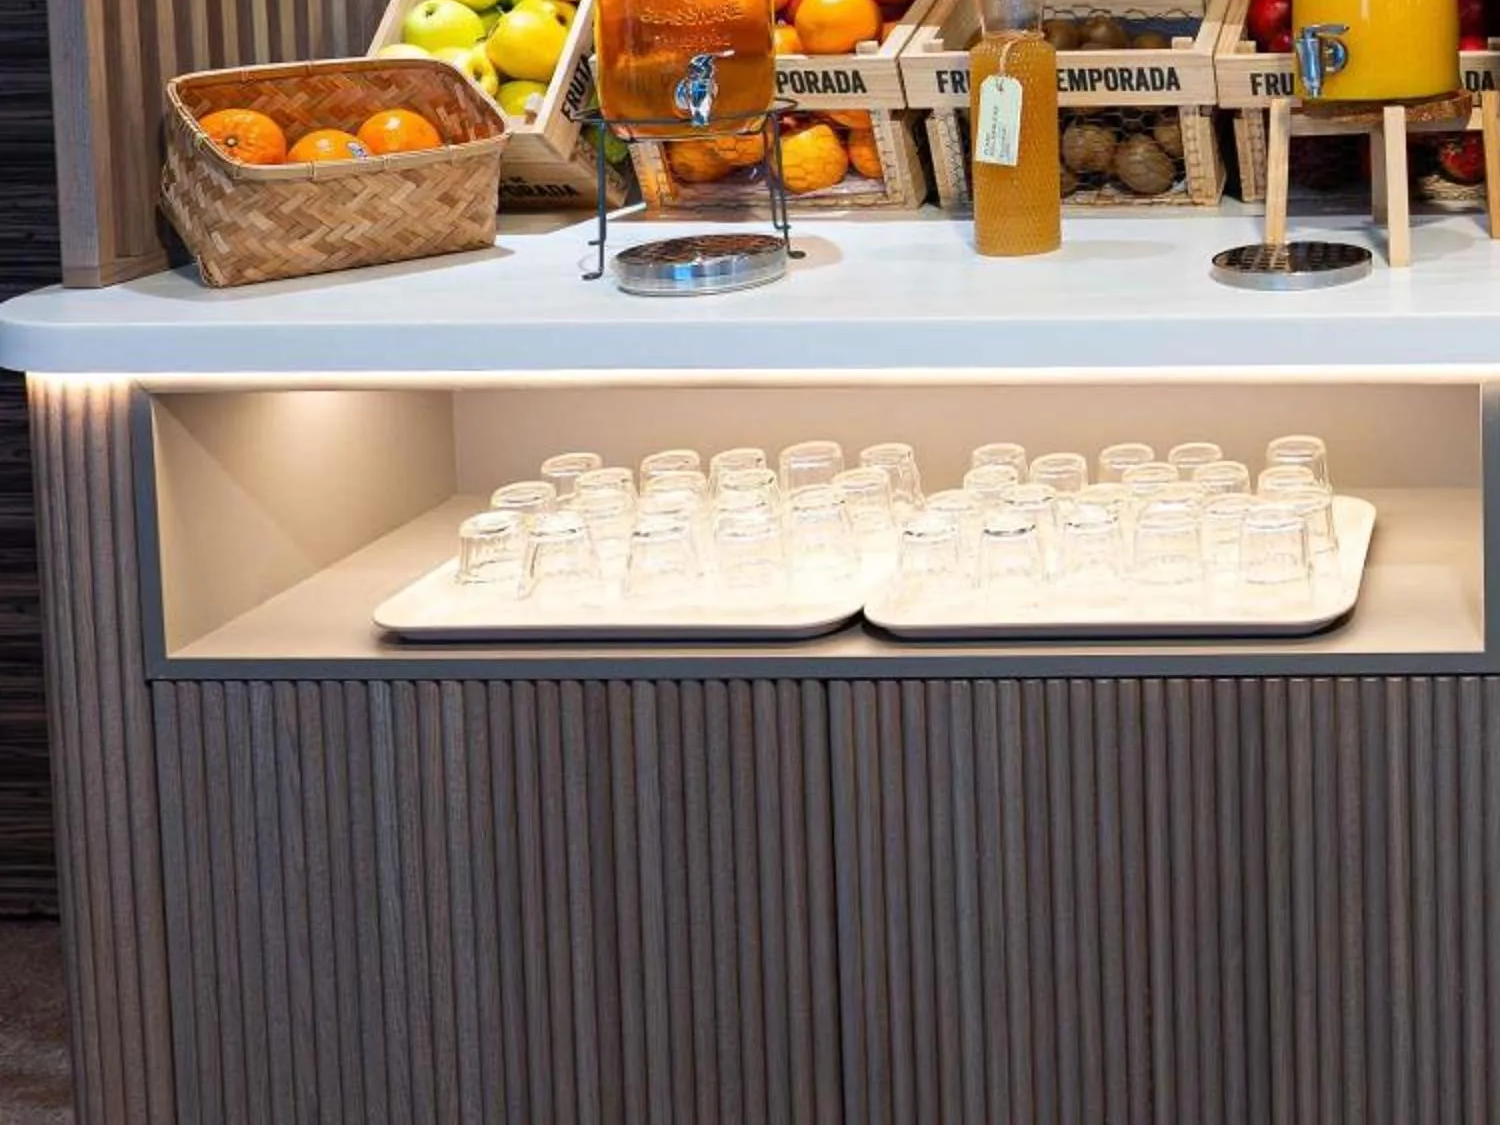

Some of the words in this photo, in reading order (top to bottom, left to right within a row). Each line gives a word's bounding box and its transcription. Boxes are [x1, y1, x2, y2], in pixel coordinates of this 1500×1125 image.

[775, 69, 867, 94] PORADA
[1056, 67, 1181, 92] EMPORADA
[1250, 72, 1295, 96] FRU
